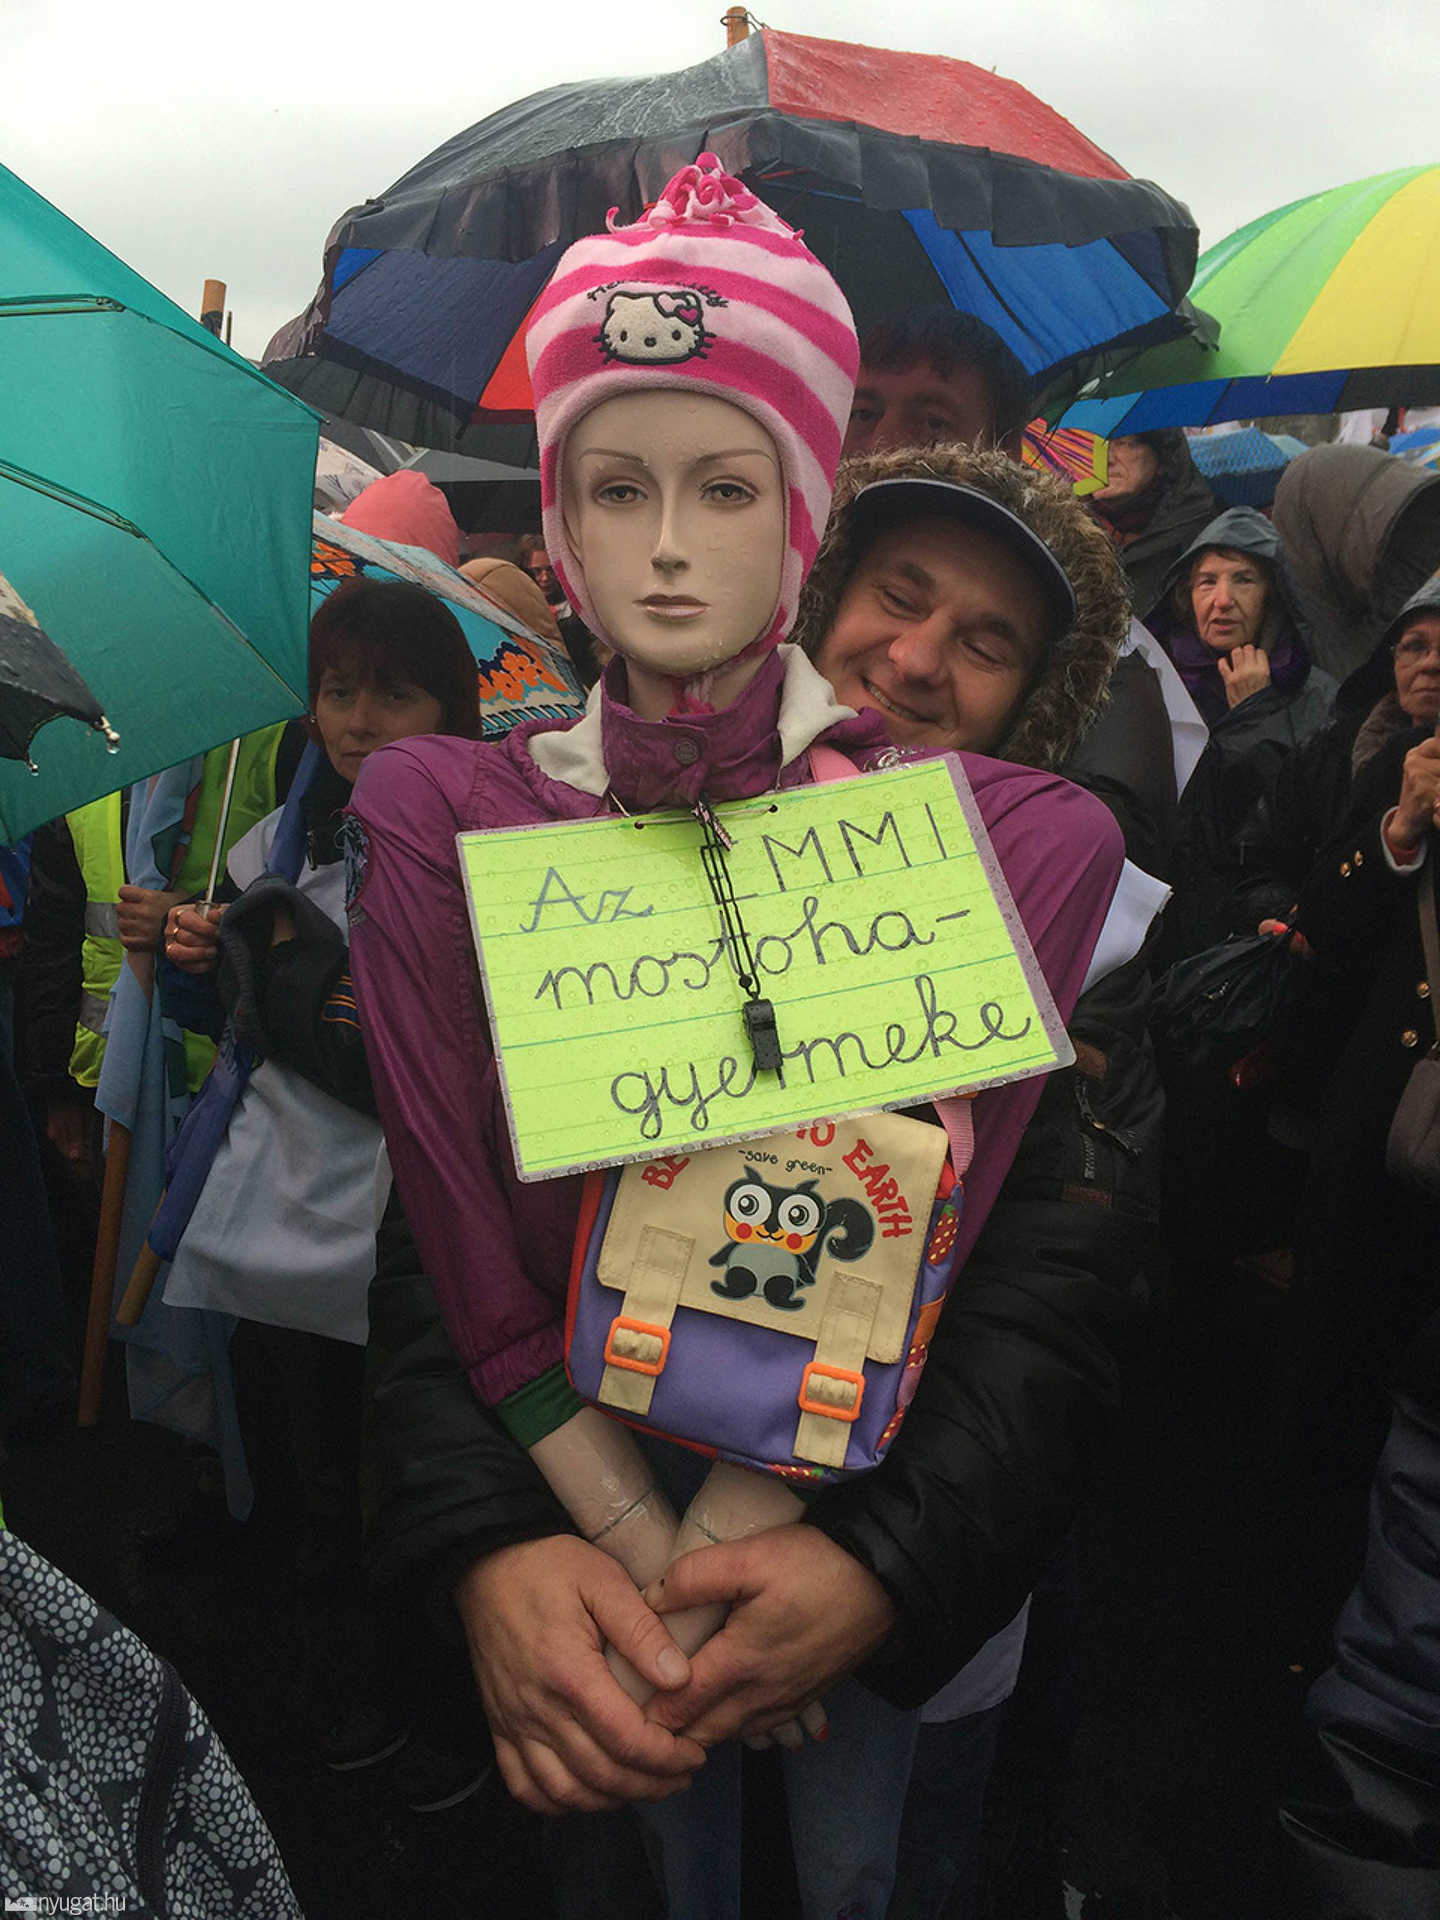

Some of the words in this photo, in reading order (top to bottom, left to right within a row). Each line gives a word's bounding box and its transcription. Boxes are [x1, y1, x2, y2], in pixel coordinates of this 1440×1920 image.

[519, 866, 654, 933] Az
[533, 896, 971, 1010] mostoha-
[842, 1139, 913, 1239] EARTH
